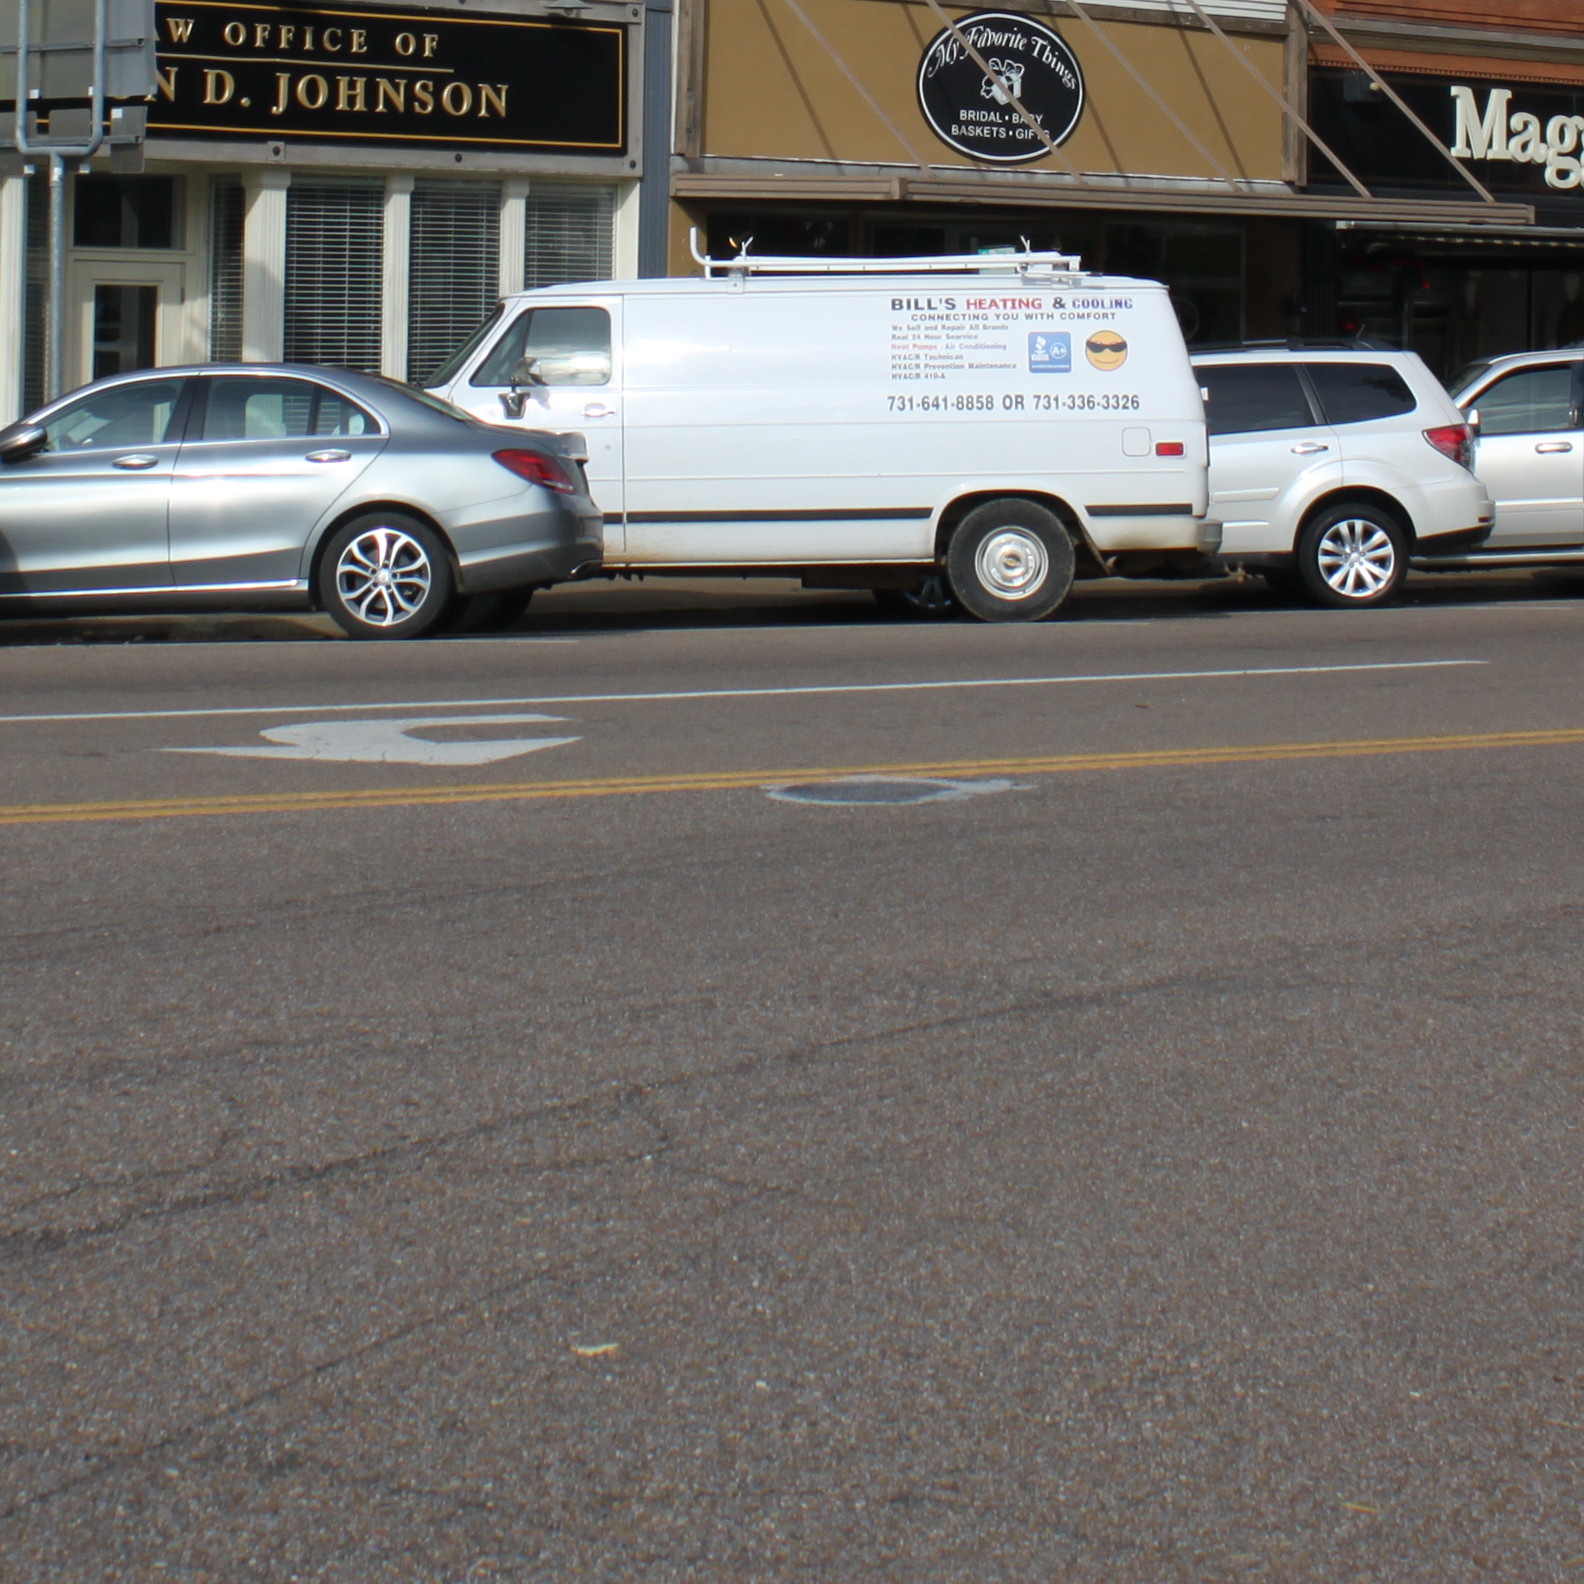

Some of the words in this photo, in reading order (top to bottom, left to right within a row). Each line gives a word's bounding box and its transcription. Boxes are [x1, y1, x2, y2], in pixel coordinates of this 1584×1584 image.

[224, 21, 368, 53] OFFICE
[395, 32, 439, 58] OF
[959, 25, 1028, 60] Favorite
[1031, 35, 1077, 90] Things
[203, 68, 251, 108] D.
[271, 72, 509, 118] JOHNSON
[959, 109, 1003, 123] BRIDAL
[951, 124, 1006, 138] BASKETS
[890, 298, 957, 311] BILL'S
[966, 297, 1043, 310] HEATING
[1052, 296, 1066, 310] &
[1072, 297, 1133, 310] COOLING
[911, 312, 989, 321] CONNECTING
[994, 312, 1019, 321] YOU
[1024, 312, 1055, 321] WITH
[1059, 312, 1117, 320] COMFORT
[941, 324, 966, 332] Repair
[912, 343, 938, 351] Pumps
[959, 343, 1007, 351] Conditioning
[887, 395, 995, 411] 731-641-8858
[1002, 395, 1025, 410] OR
[1033, 394, 1140, 410] 731-336-3326
